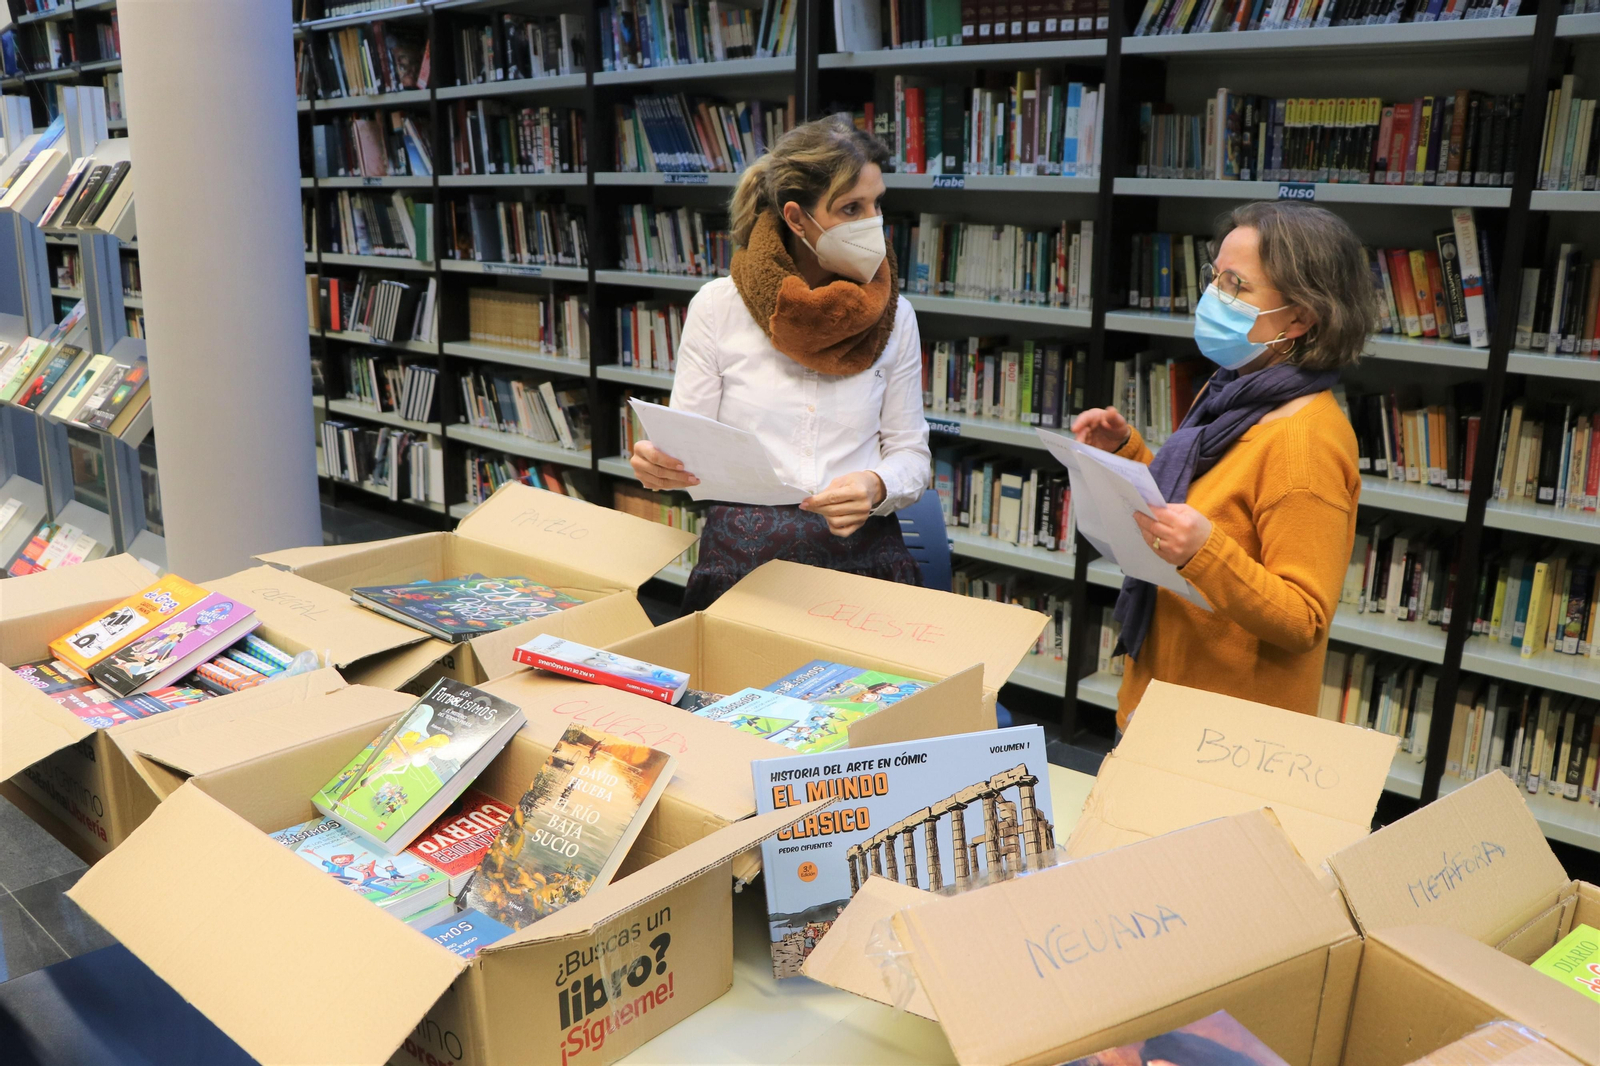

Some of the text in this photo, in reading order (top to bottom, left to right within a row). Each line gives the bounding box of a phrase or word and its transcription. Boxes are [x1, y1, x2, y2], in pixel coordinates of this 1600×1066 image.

[1279, 185, 1315, 199] Ruso
[1034, 348, 1042, 370] PREY
[928, 420, 961, 434] rancés
[807, 600, 945, 643] CELESTE
[460, 689, 472, 698] LOS
[989, 742, 1025, 754] VOLUMEN
[1197, 728, 1340, 790] BOTERO
[578, 764, 618, 787] DAVID
[770, 752, 928, 783] HISTORIA DEL ARTE EN CÓMIC
[568, 775, 613, 802] TRUEBA
[771, 772, 890, 809] EL MUNDO
[552, 796, 601, 825] EL RÍO
[417, 804, 511, 854] CUERVO
[547, 814, 584, 839] BAJA
[430, 825, 503, 864] XANDER
[531, 828, 580, 858] SUCIO
[778, 841, 833, 855] PEDRO CIFUENTES
[1407, 841, 1507, 908] METÁFORA
[555, 906, 672, 987] ¿Buscas un
[1553, 939, 1600, 974] DIARIO
[558, 931, 672, 1031] libro?
[559, 971, 675, 1066] ¡Sígueme!
